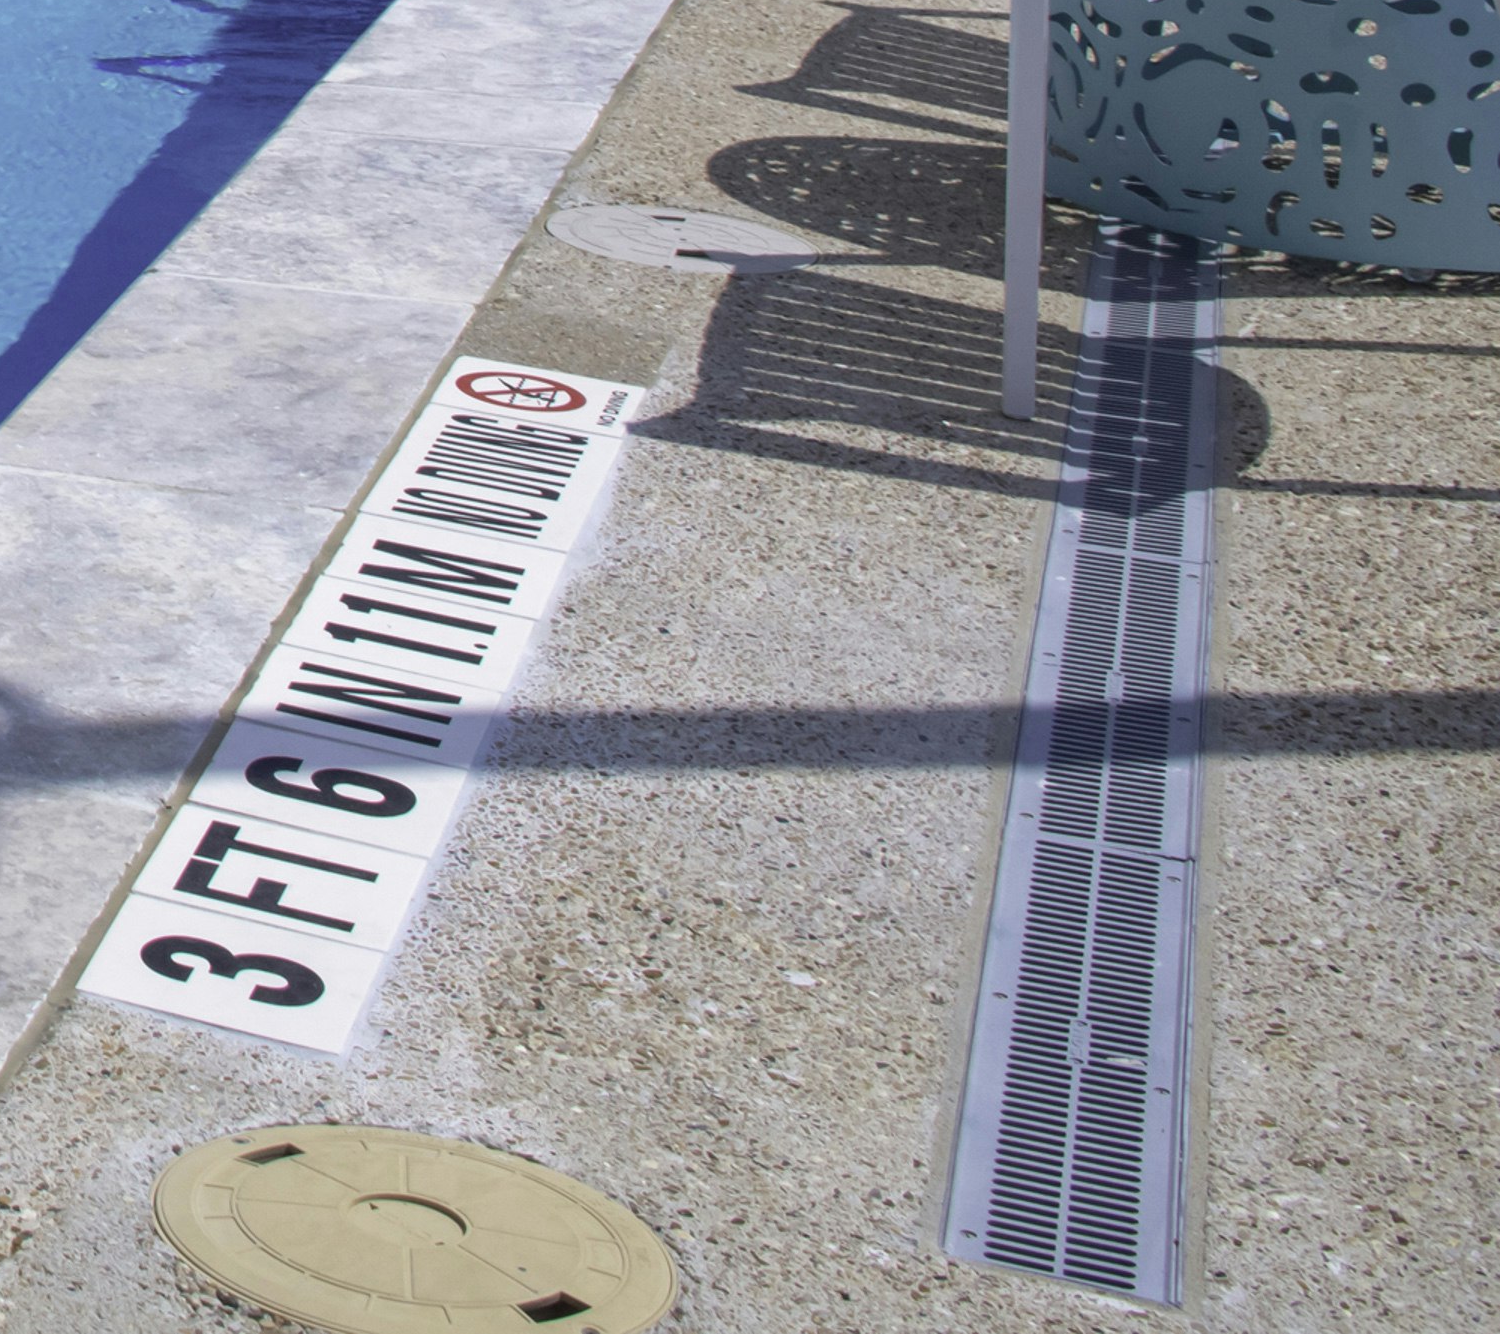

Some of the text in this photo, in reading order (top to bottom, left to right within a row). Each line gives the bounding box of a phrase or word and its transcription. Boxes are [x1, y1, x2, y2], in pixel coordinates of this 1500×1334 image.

[415, 414, 589, 501] DIVING
[596, 415, 616, 428] NO
[392, 488, 547, 539] NO
[275, 662, 462, 748] IN
[245, 756, 416, 817] 6
[173, 820, 379, 932] FT
[140, 935, 325, 1007] 3
